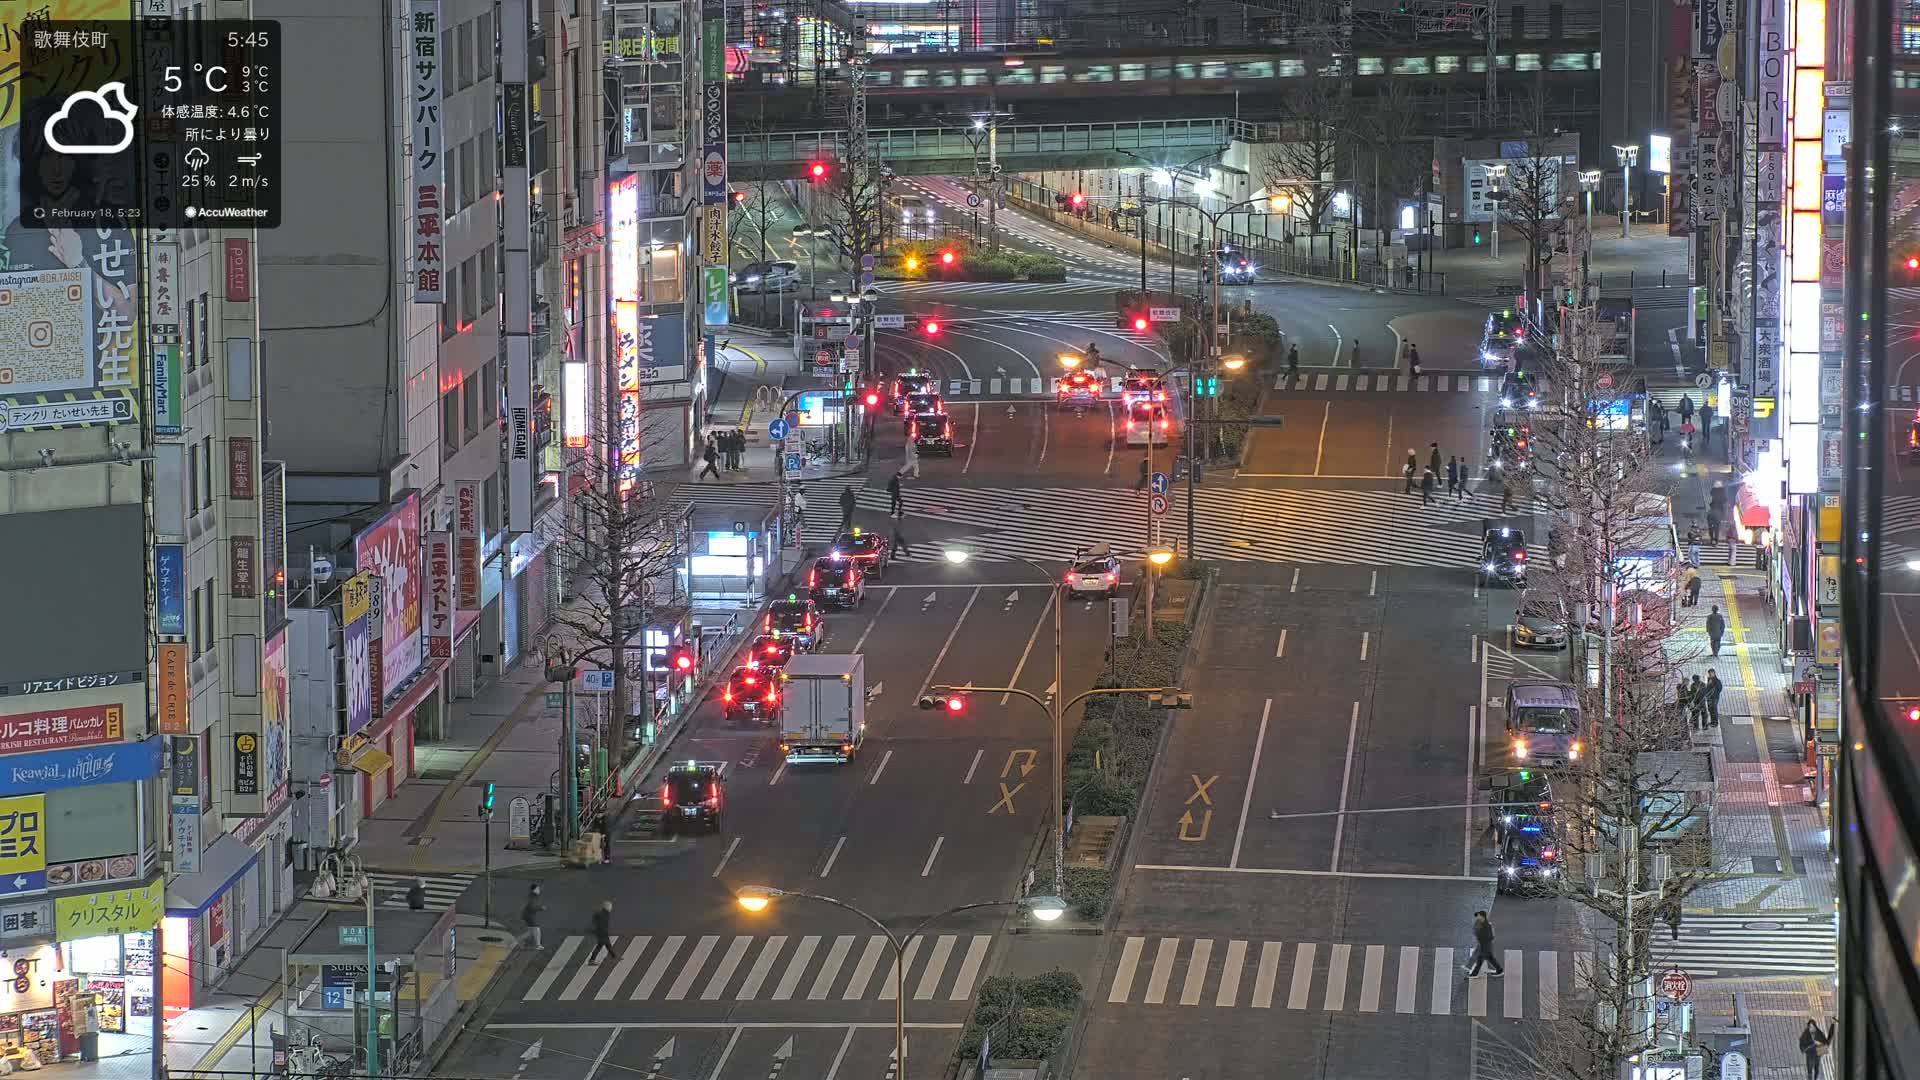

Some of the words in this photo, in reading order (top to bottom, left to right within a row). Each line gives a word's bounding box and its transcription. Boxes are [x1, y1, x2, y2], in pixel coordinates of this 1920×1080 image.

[415, 12, 437, 169] 新宿サンパーク
[1705, 88, 1716, 121] アコム
[706, 160, 723, 178] 薬
[417, 184, 440, 291] 三平本館
[709, 208, 722, 263] 肉汁水餃子
[708, 271, 722, 313] レイク
[156, 325, 175, 333] 3F
[1759, 330, 1772, 383] 大衆酒場
[156, 354, 168, 415] FamilyMart
[13, 412, 48, 422] テンクリ
[53, 403, 110, 418] たいせい先生
[512, 407, 527, 461] HOMEGAME
[459, 487, 470, 532] GAME
[236, 547, 249, 584] 龍生堂
[432, 543, 448, 629] 三平ストア
[23, 678, 74, 694] リアエイド
[77, 675, 118, 688] ビジョン
[0, 716, 68, 739] ルコ料理
[108, 711, 119, 737] 5F
[24, 736, 67, 747] RESTAURANT
[0, 811, 38, 836] プロ
[0, 835, 39, 858] ミス
[3, 911, 38, 932] 囲碁
[69, 904, 141, 928] クリスタル
[325, 992, 341, 1004] 12
[1664, 980, 1686, 991] 消火栓
